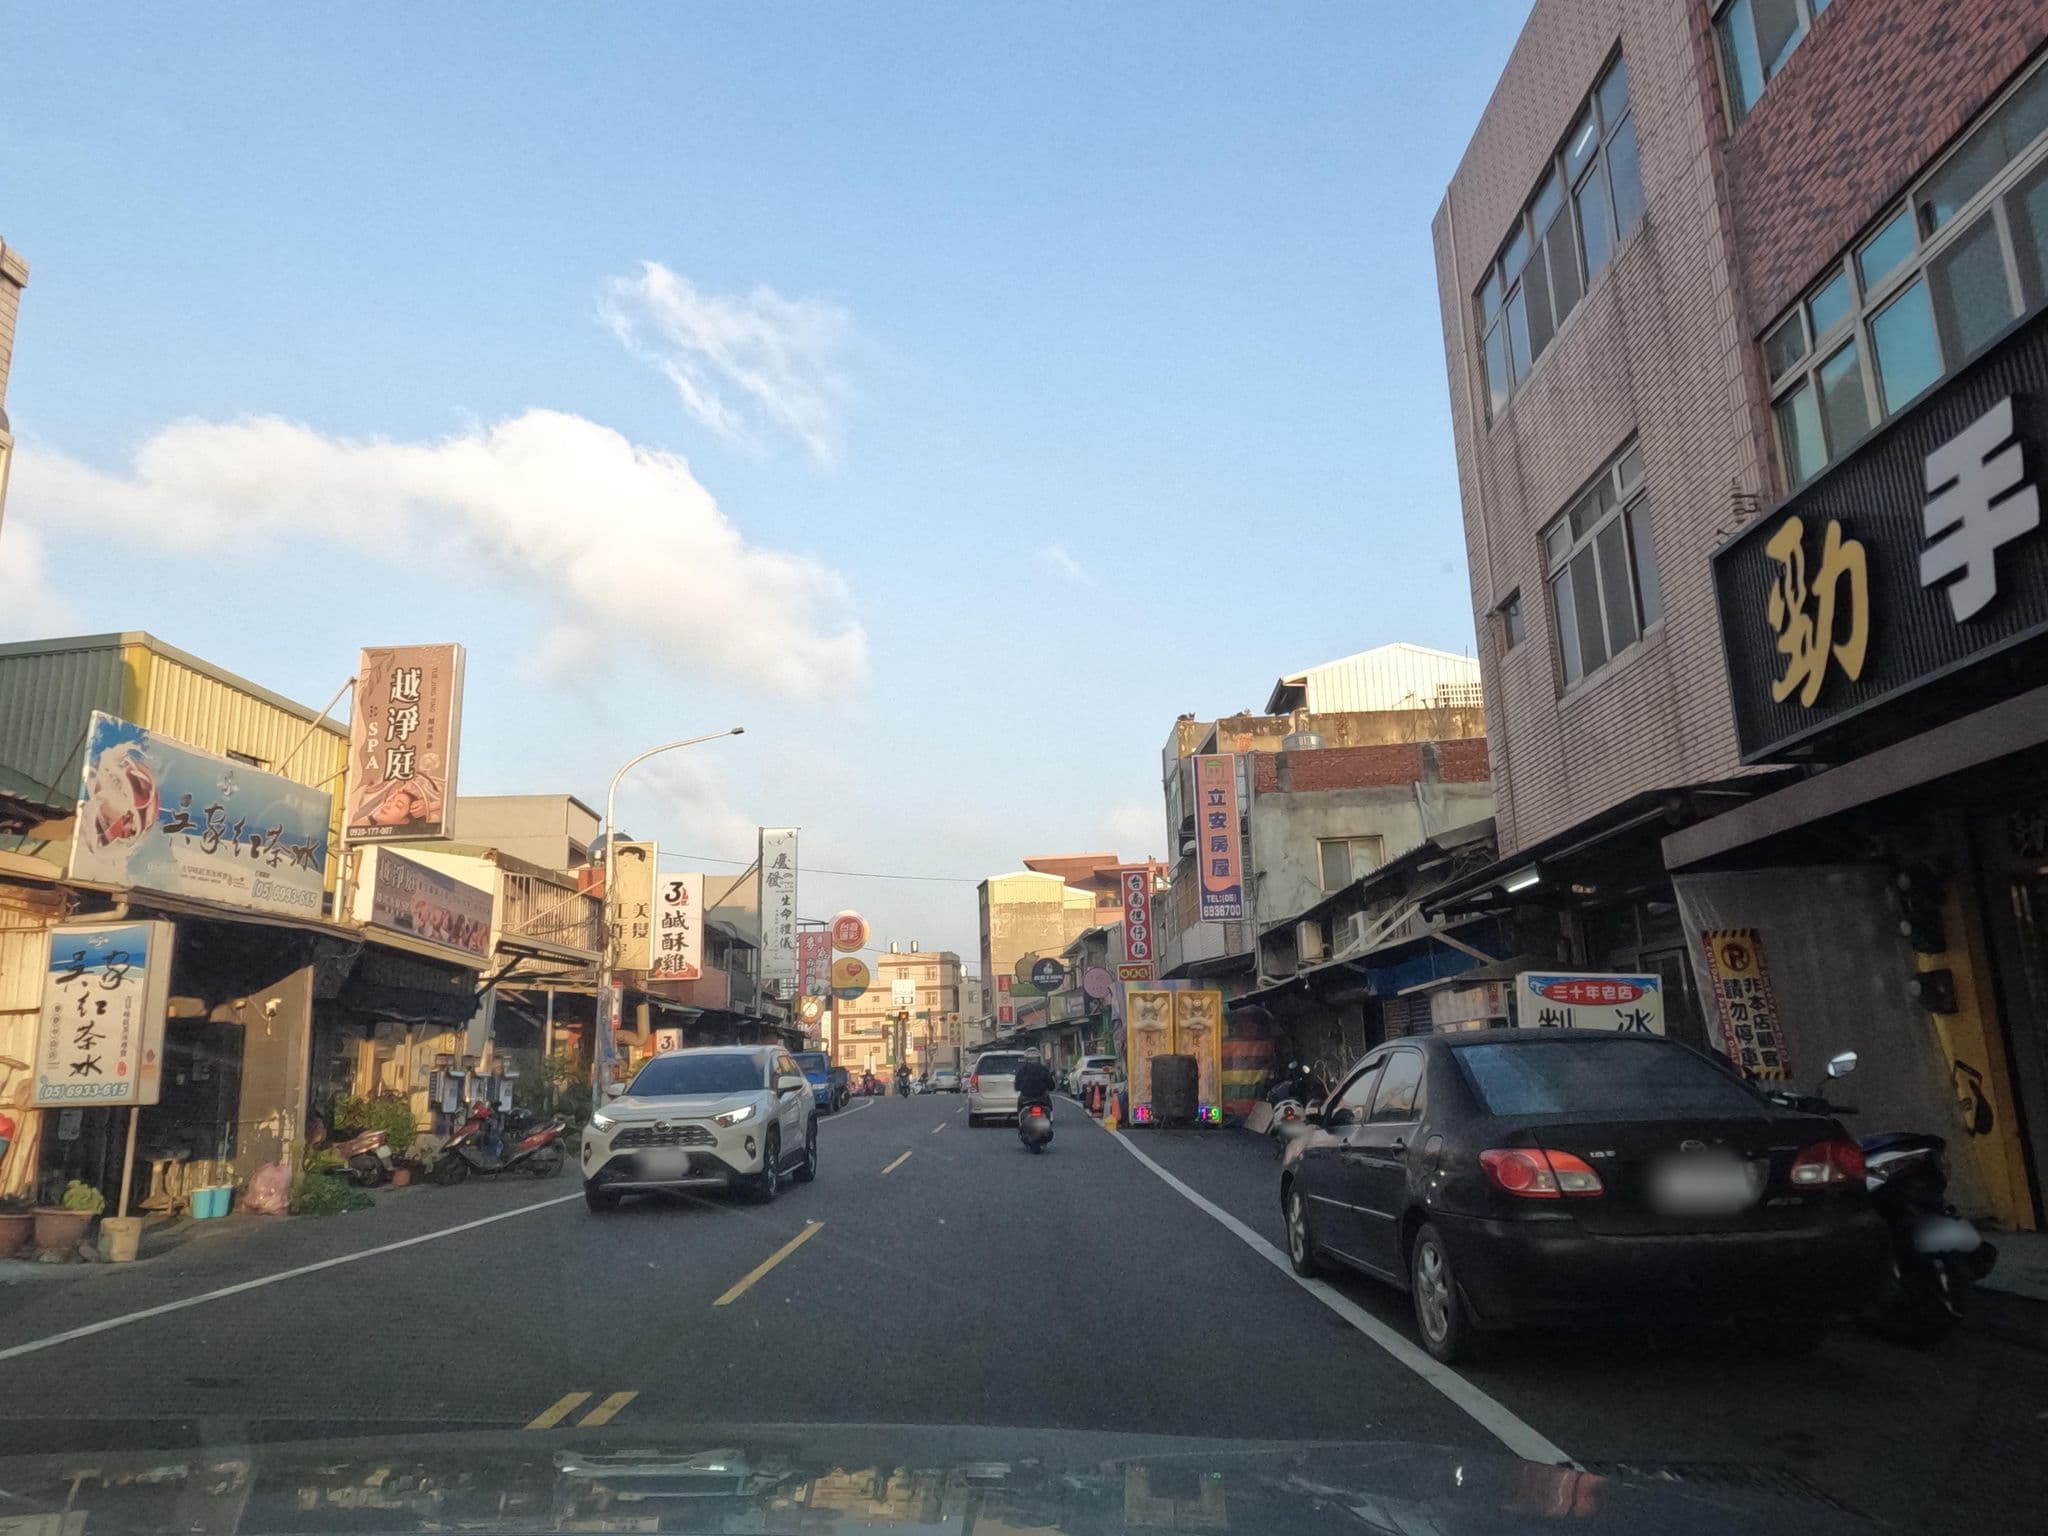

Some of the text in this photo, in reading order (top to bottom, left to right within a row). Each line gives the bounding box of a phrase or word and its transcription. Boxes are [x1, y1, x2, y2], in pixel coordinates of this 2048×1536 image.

[365, 722, 379, 770] SPA
[384, 666, 422, 781] 越淨庭
[1207, 788, 1230, 877] 立安房屋
[632, 902, 649, 939] 美髮
[661, 910, 689, 973] 鹹酥雞
[779, 894, 795, 950] 生命禮儀
[1553, 985, 1633, 1000] 三十年老店
[40, 1082, 129, 1100] (05)6933-615
